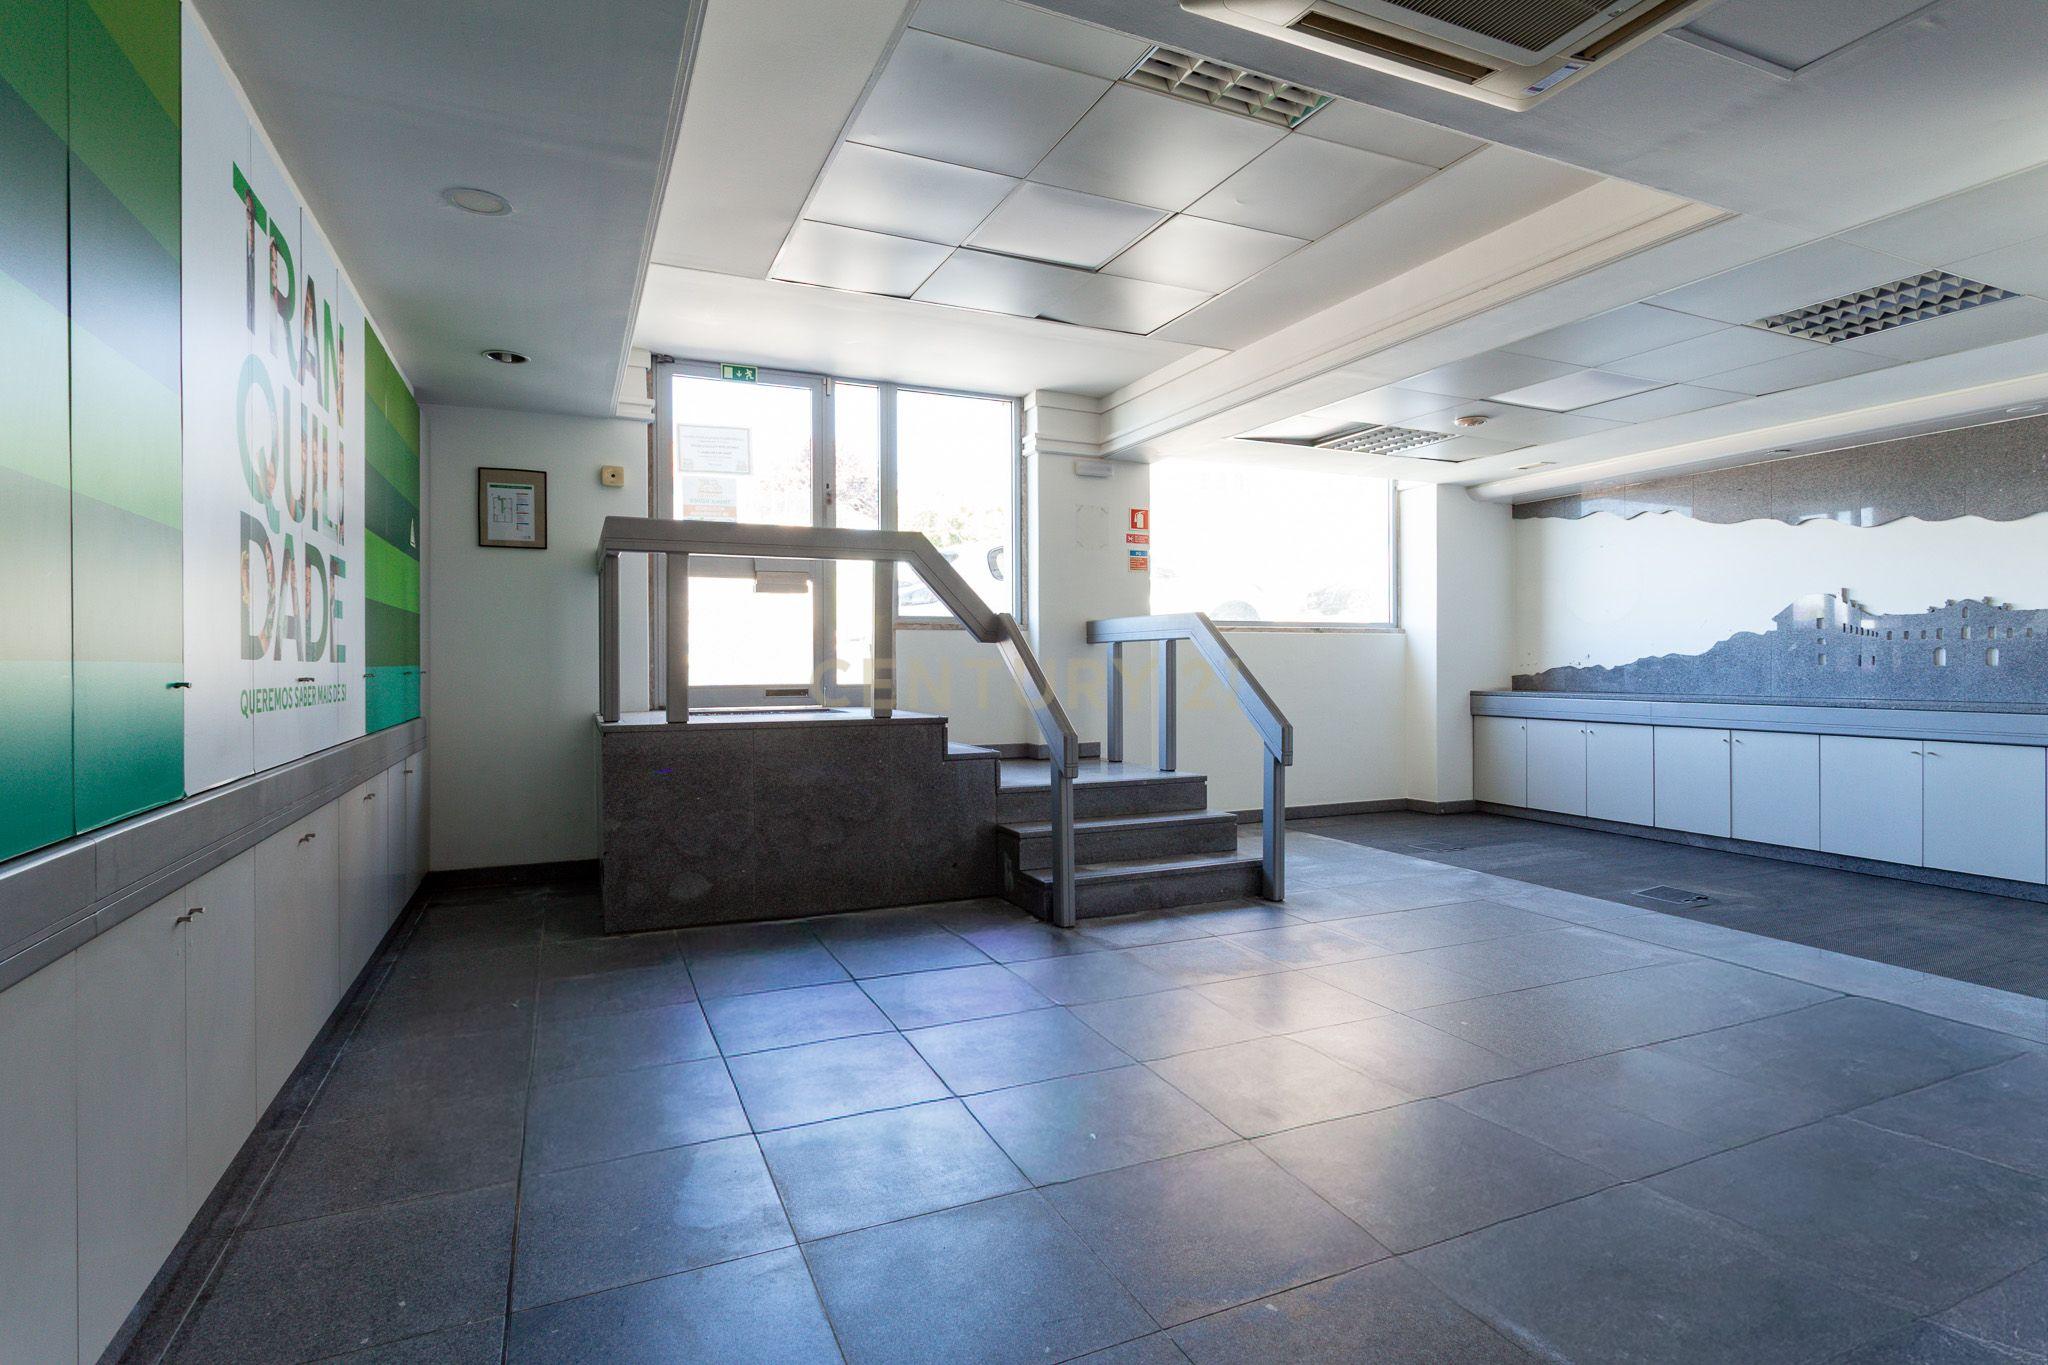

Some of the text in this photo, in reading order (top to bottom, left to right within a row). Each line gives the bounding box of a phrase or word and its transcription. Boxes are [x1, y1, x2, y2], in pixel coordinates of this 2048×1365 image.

[233, 160, 344, 430] TRAN
[236, 353, 345, 547] QUILI
[240, 510, 347, 664] DADE
[240, 687, 293, 719] QUEREMOS
[294, 685, 317, 708] SABER
[317, 685, 332, 705] MAIS
[332, 683, 342, 703] DE
